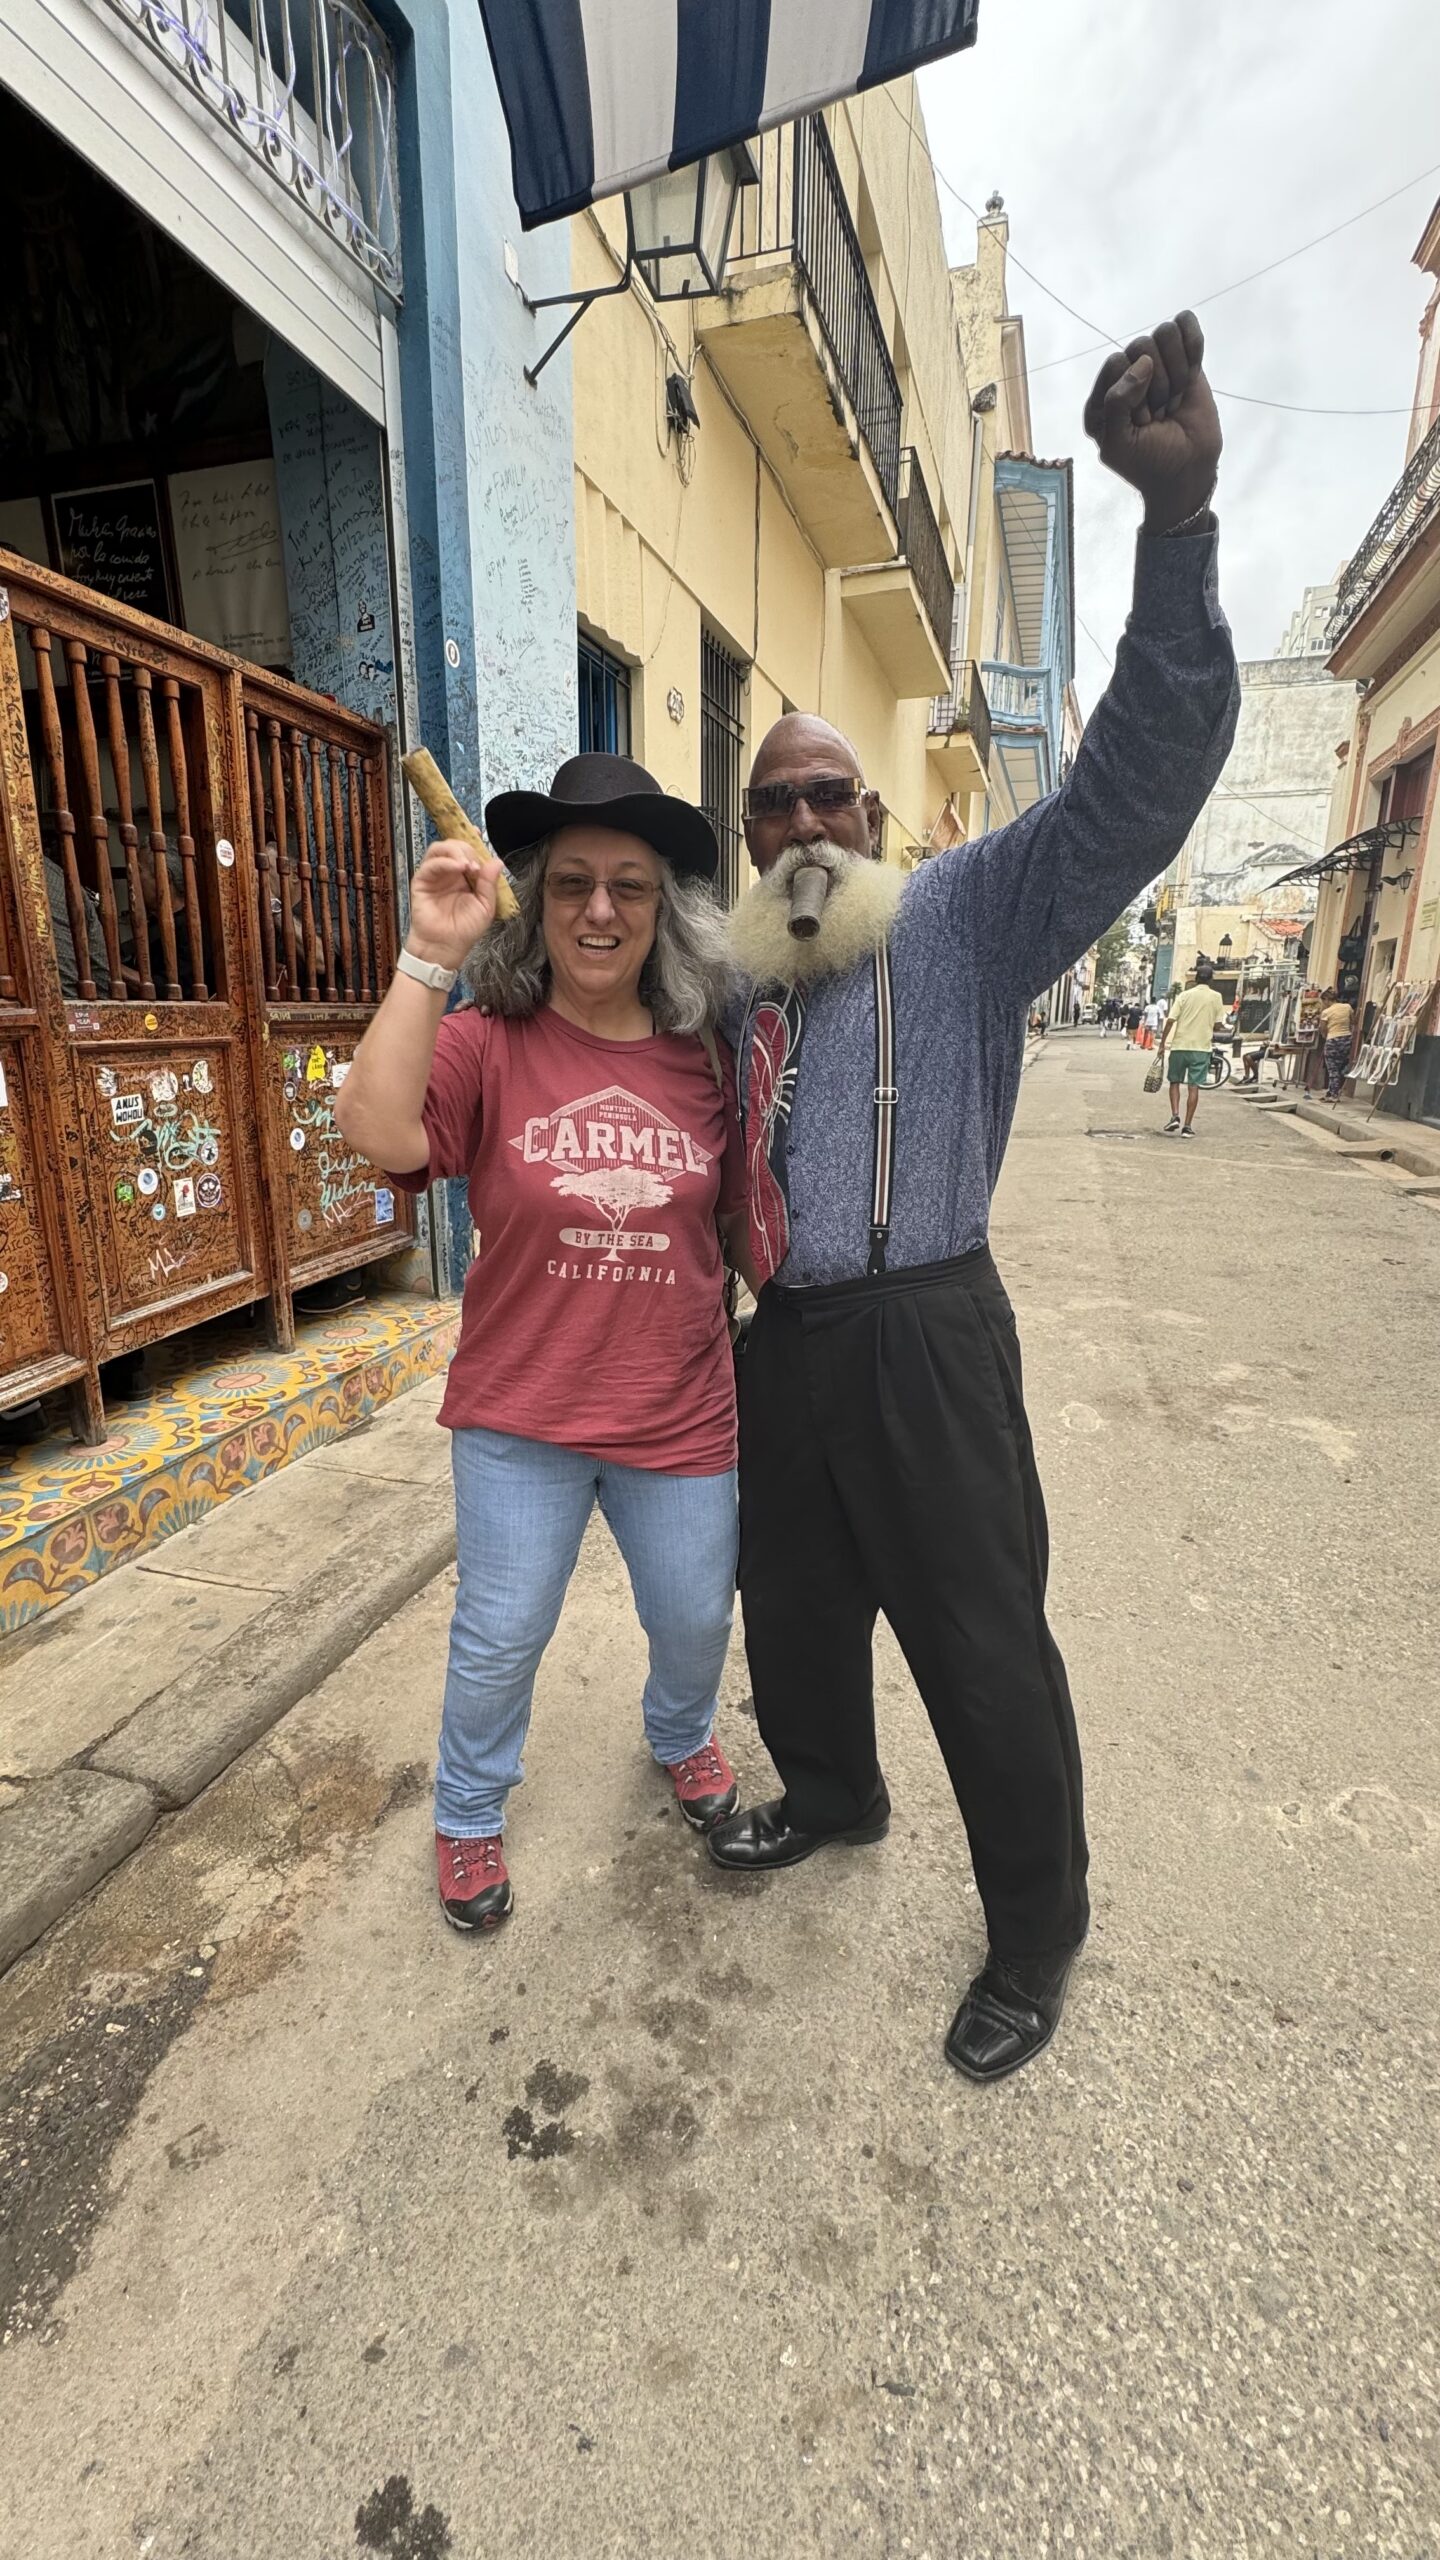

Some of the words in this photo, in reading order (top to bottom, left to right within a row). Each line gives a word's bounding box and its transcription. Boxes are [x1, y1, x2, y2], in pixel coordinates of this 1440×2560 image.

[599, 1111, 637, 1121] PENINSULA
[600, 1104, 636, 1114] MONTEREY
[523, 1117, 708, 1176] CARMEL
[575, 1231, 591, 1245] BY
[598, 1233, 624, 1247] THE
[630, 1234, 654, 1248] SEA
[547, 1260, 676, 1285] CALIFORNIA
